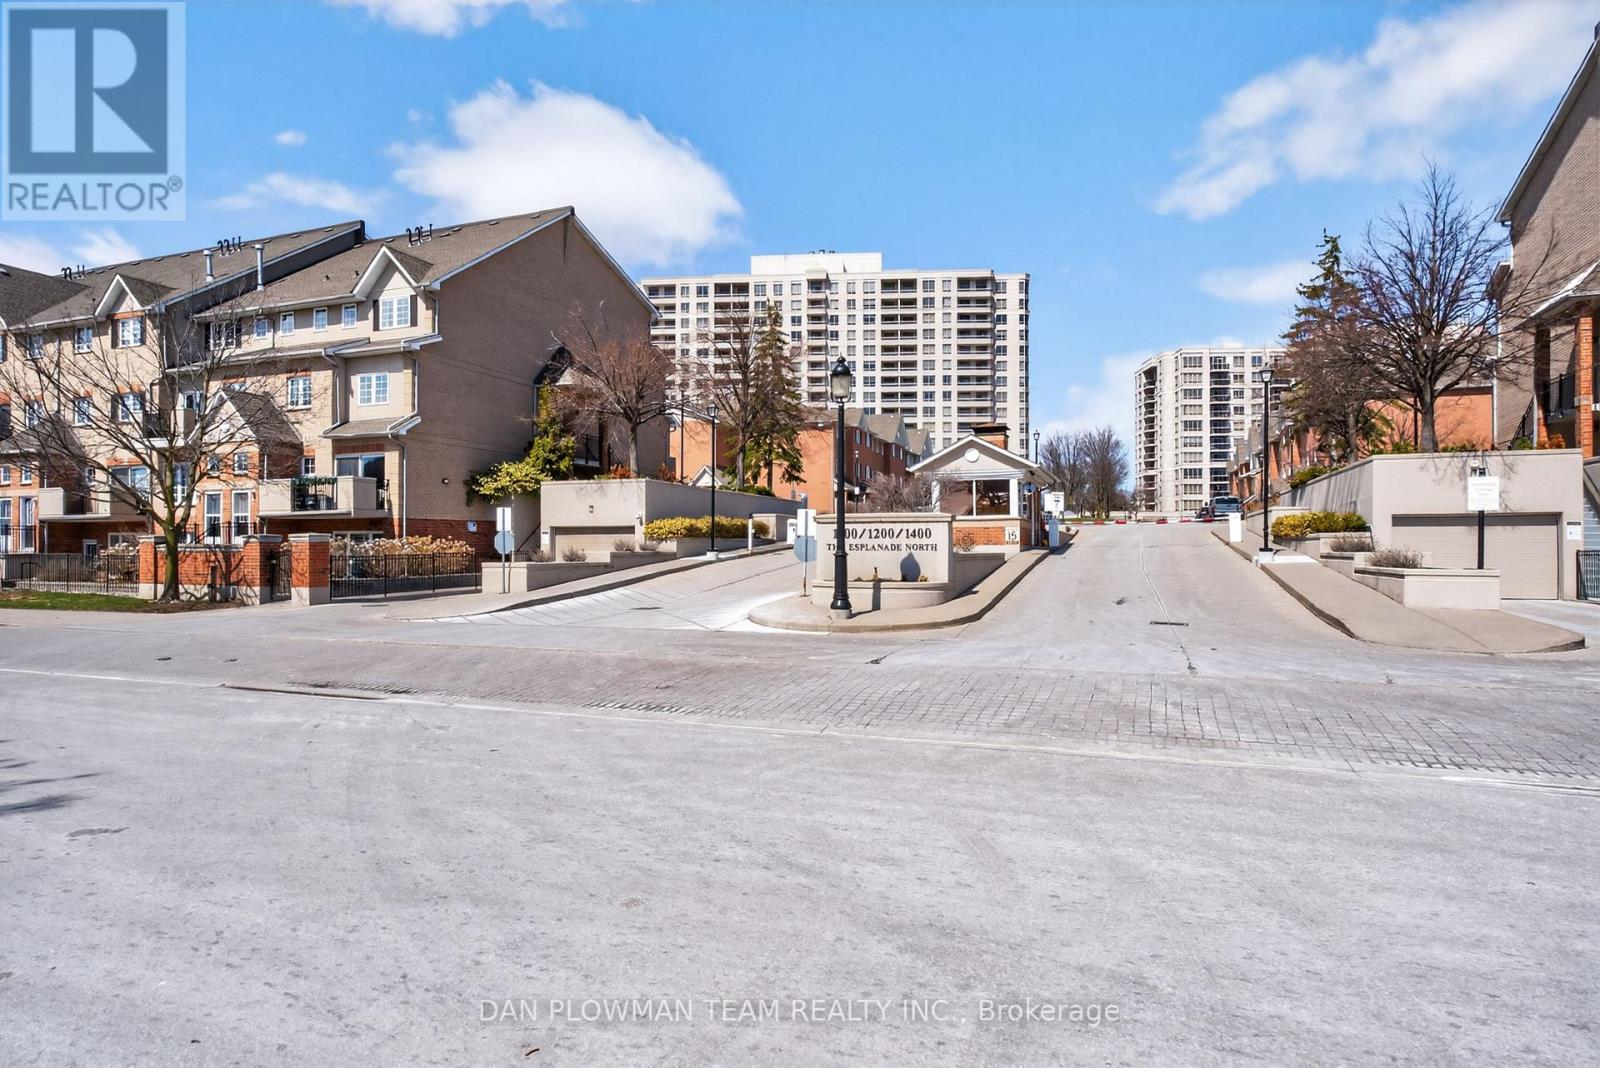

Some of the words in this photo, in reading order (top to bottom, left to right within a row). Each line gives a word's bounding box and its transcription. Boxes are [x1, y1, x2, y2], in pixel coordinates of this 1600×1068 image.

[833, 528, 932, 539] 100/1200/1400
[849, 543, 902, 551] ESPLANADE
[905, 543, 938, 551] NORTH
